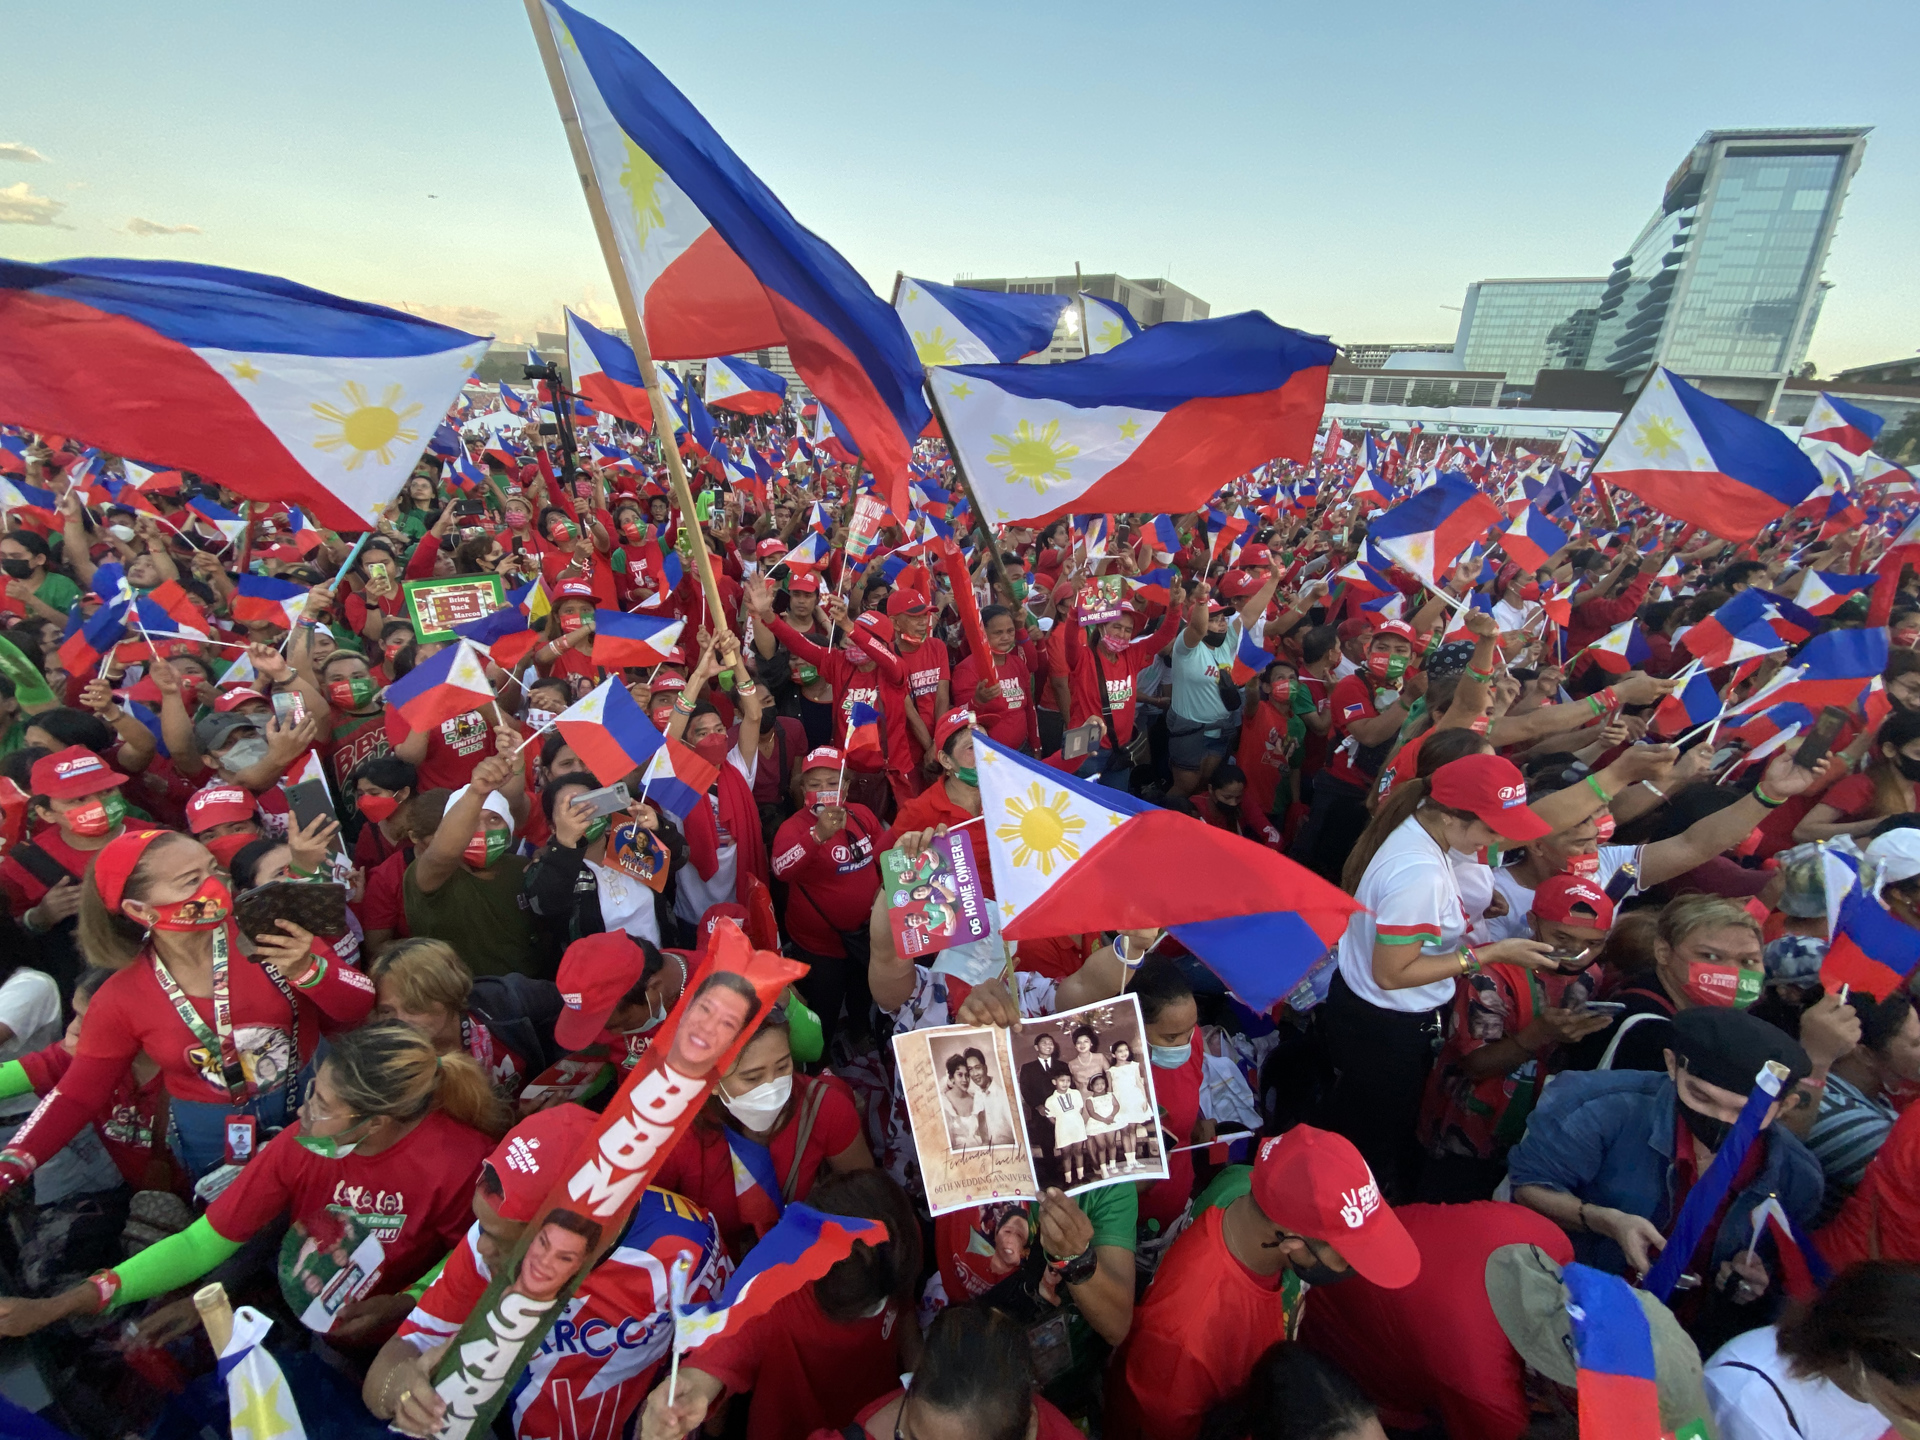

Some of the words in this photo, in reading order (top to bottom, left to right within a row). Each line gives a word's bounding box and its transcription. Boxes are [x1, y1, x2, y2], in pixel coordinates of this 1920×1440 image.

[450, 603, 470, 611] Back
[454, 611, 481, 619] Marcos
[458, 741, 484, 756] 2022
[835, 846, 848, 860] #7
[619, 858, 653, 881] VILLAR
[951, 844, 970, 883] OWNER
[959, 884, 978, 917] HOME
[969, 917, 982, 936] 06
[156, 968, 171, 988] BBM
[178, 1006, 195, 1025] SARA
[219, 1004, 230, 1026] BBM
[567, 1061, 706, 1217] BBM
[934, 1184, 953, 1194] 66TH
[954, 1175, 992, 1189] WEDDING
[993, 1172, 1033, 1183] ANNIVERS
